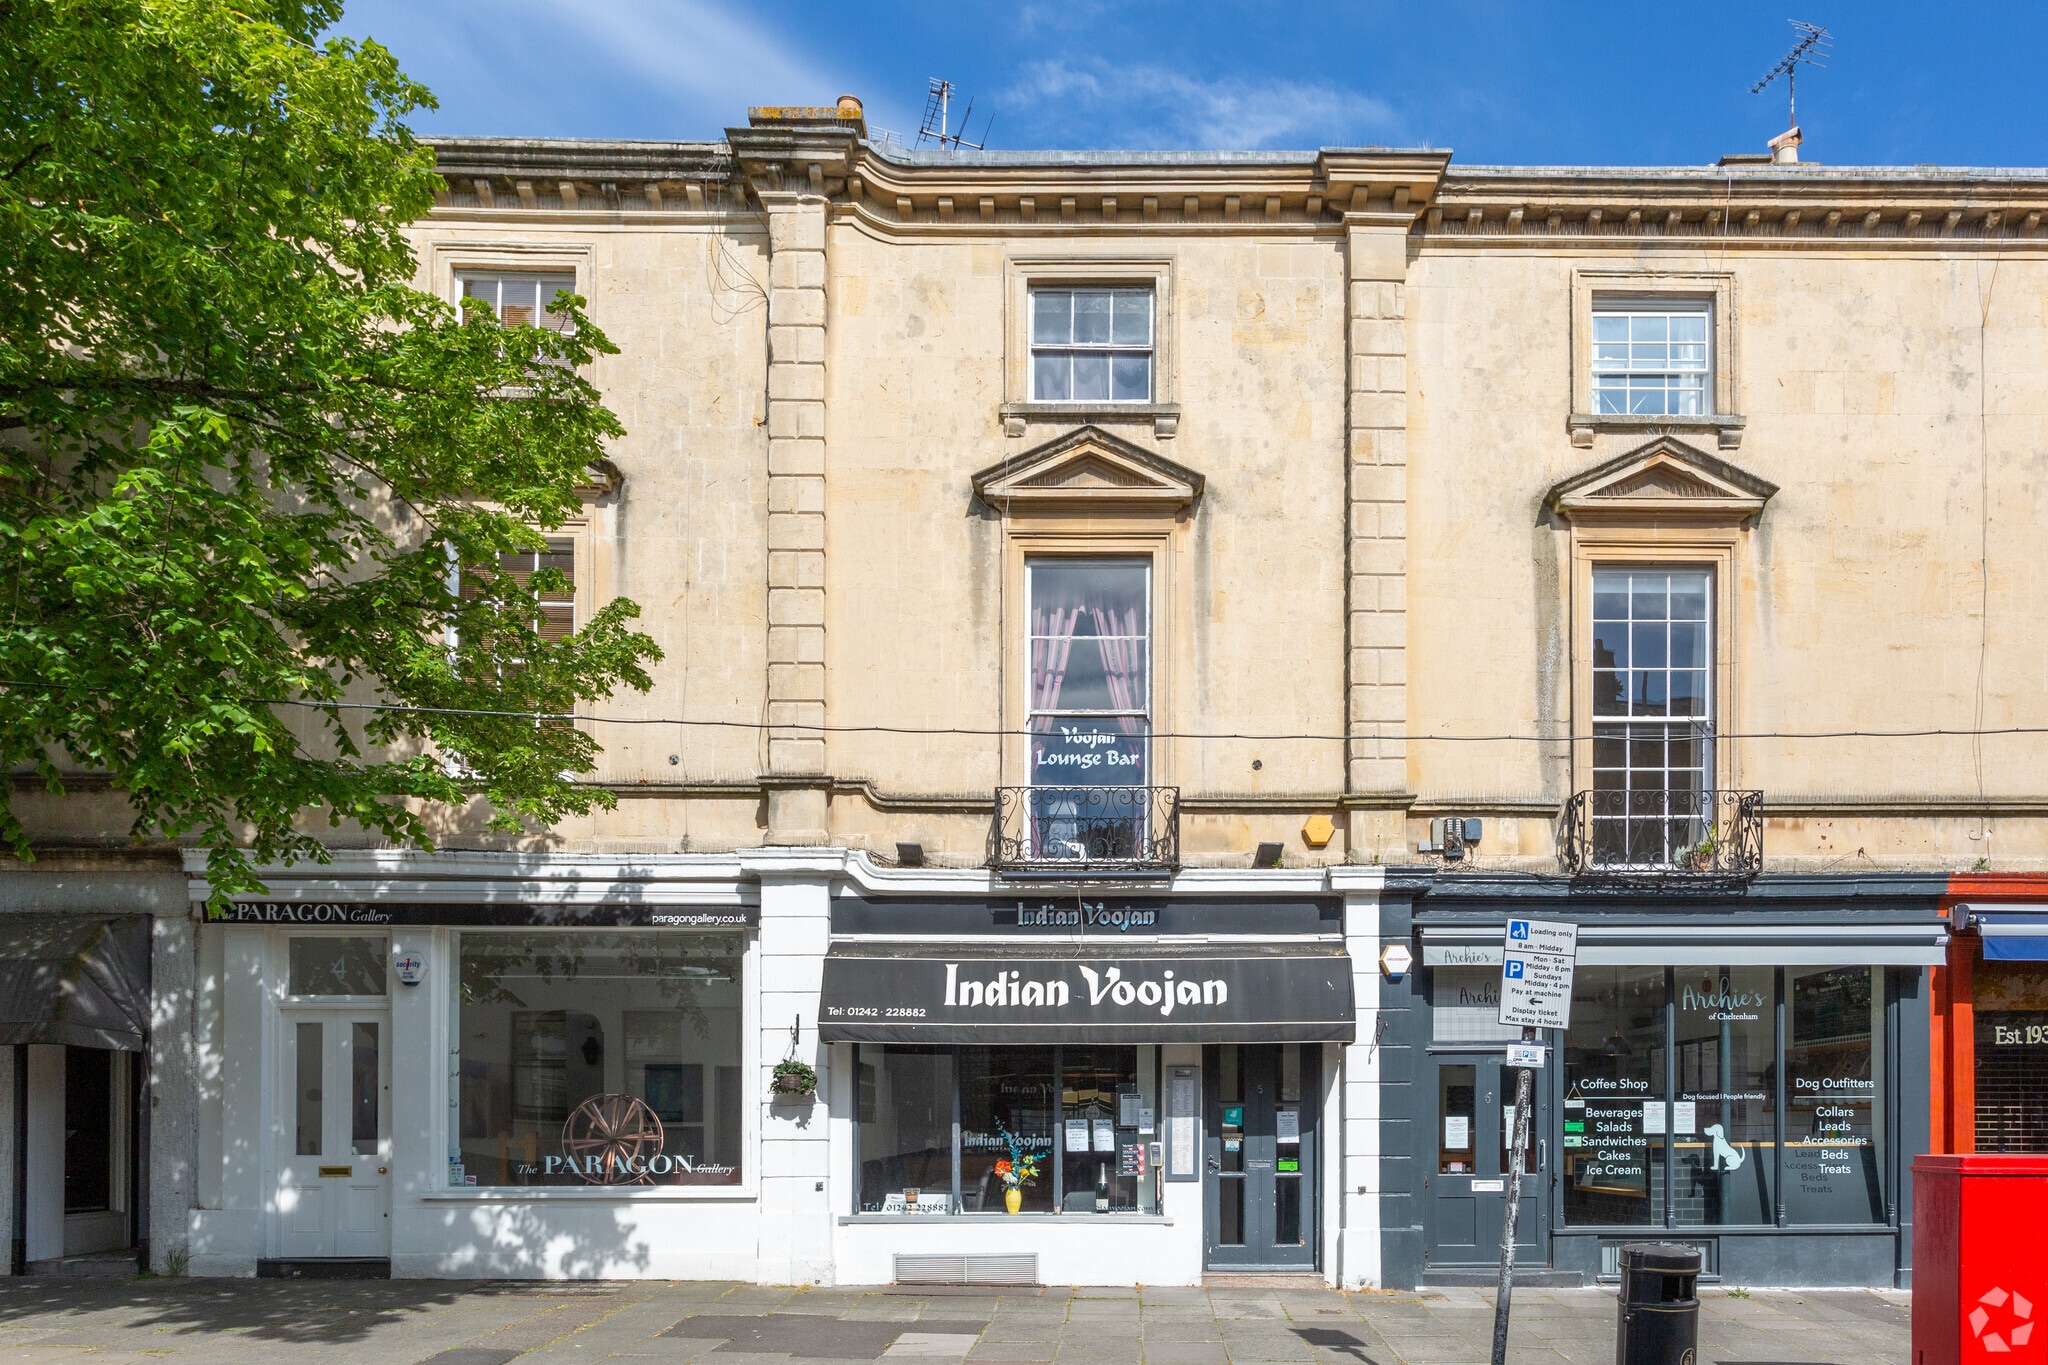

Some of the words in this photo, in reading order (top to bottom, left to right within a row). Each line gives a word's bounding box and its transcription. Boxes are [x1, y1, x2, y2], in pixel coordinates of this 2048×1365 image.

[1060, 726, 1116, 748] Voojan
[1036, 750, 1101, 769] Lounge
[1106, 750, 1140, 766] Bar
[236, 904, 348, 921] PARAGON
[350, 910, 392, 924] Gallery
[1018, 902, 1079, 926] Indian
[1081, 902, 1156, 932] Voojan
[652, 914, 746, 925] paragongallery.co.uk
[1530, 928, 1556, 936] Loading
[1558, 930, 1572, 938] only
[1539, 944, 1563, 952] Midday
[1445, 945, 1491, 963] Archie's
[330, 954, 346, 978] 4
[1526, 963, 1550, 971] Midday
[1534, 973, 1562, 981] Sundays
[1524, 980, 1548, 988] Midday
[944, 964, 1069, 1007] Indian
[1078, 964, 1228, 1016] Voojan
[1460, 982, 1501, 1004] Archi
[1534, 990, 1561, 998] machine
[1682, 976, 1767, 1010] Archie's
[828, 1007, 845, 1016] Tel:
[847, 1007, 878, 1016] 01242
[885, 1008, 926, 1017] 228882
[1512, 1007, 1536, 1015] Display
[1708, 1012, 1716, 1020] of
[1995, 1026, 2023, 1044] Est
[1580, 1078, 1617, 1089] Coffee
[1620, 1078, 1648, 1091] Shop
[1796, 1078, 1819, 1090] Dog
[1822, 1077, 1874, 1088] Outfitters
[1257, 1085, 1263, 1093] 5
[1485, 1092, 1492, 1104] 6
[1683, 1093, 1695, 1101] Dog
[1586, 1108, 1643, 1120] Beverages
[1816, 1106, 1854, 1116] Collars
[1596, 1121, 1632, 1132] Salads
[1819, 1121, 1851, 1131] Leads
[963, 1131, 1003, 1146] Indian
[1004, 1131, 1051, 1150] Voojan
[1582, 1136, 1647, 1146] Sandwiches
[1803, 1135, 1867, 1145] Accessories
[1598, 1150, 1631, 1160] Cakes
[1822, 1149, 1848, 1159] Beds
[518, 1164, 537, 1174] The
[543, 1154, 694, 1174] PARAGON
[696, 1164, 734, 1176] Gallery
[1587, 1165, 1602, 1175] Ice
[1605, 1165, 1641, 1175] Cream
[1819, 1164, 1851, 1174] Treats
[1800, 1185, 1832, 1193] Treats
[864, 1202, 882, 1211] Tel:
[886, 1204, 912, 1212] 01242
[916, 1204, 948, 1213] 228882
